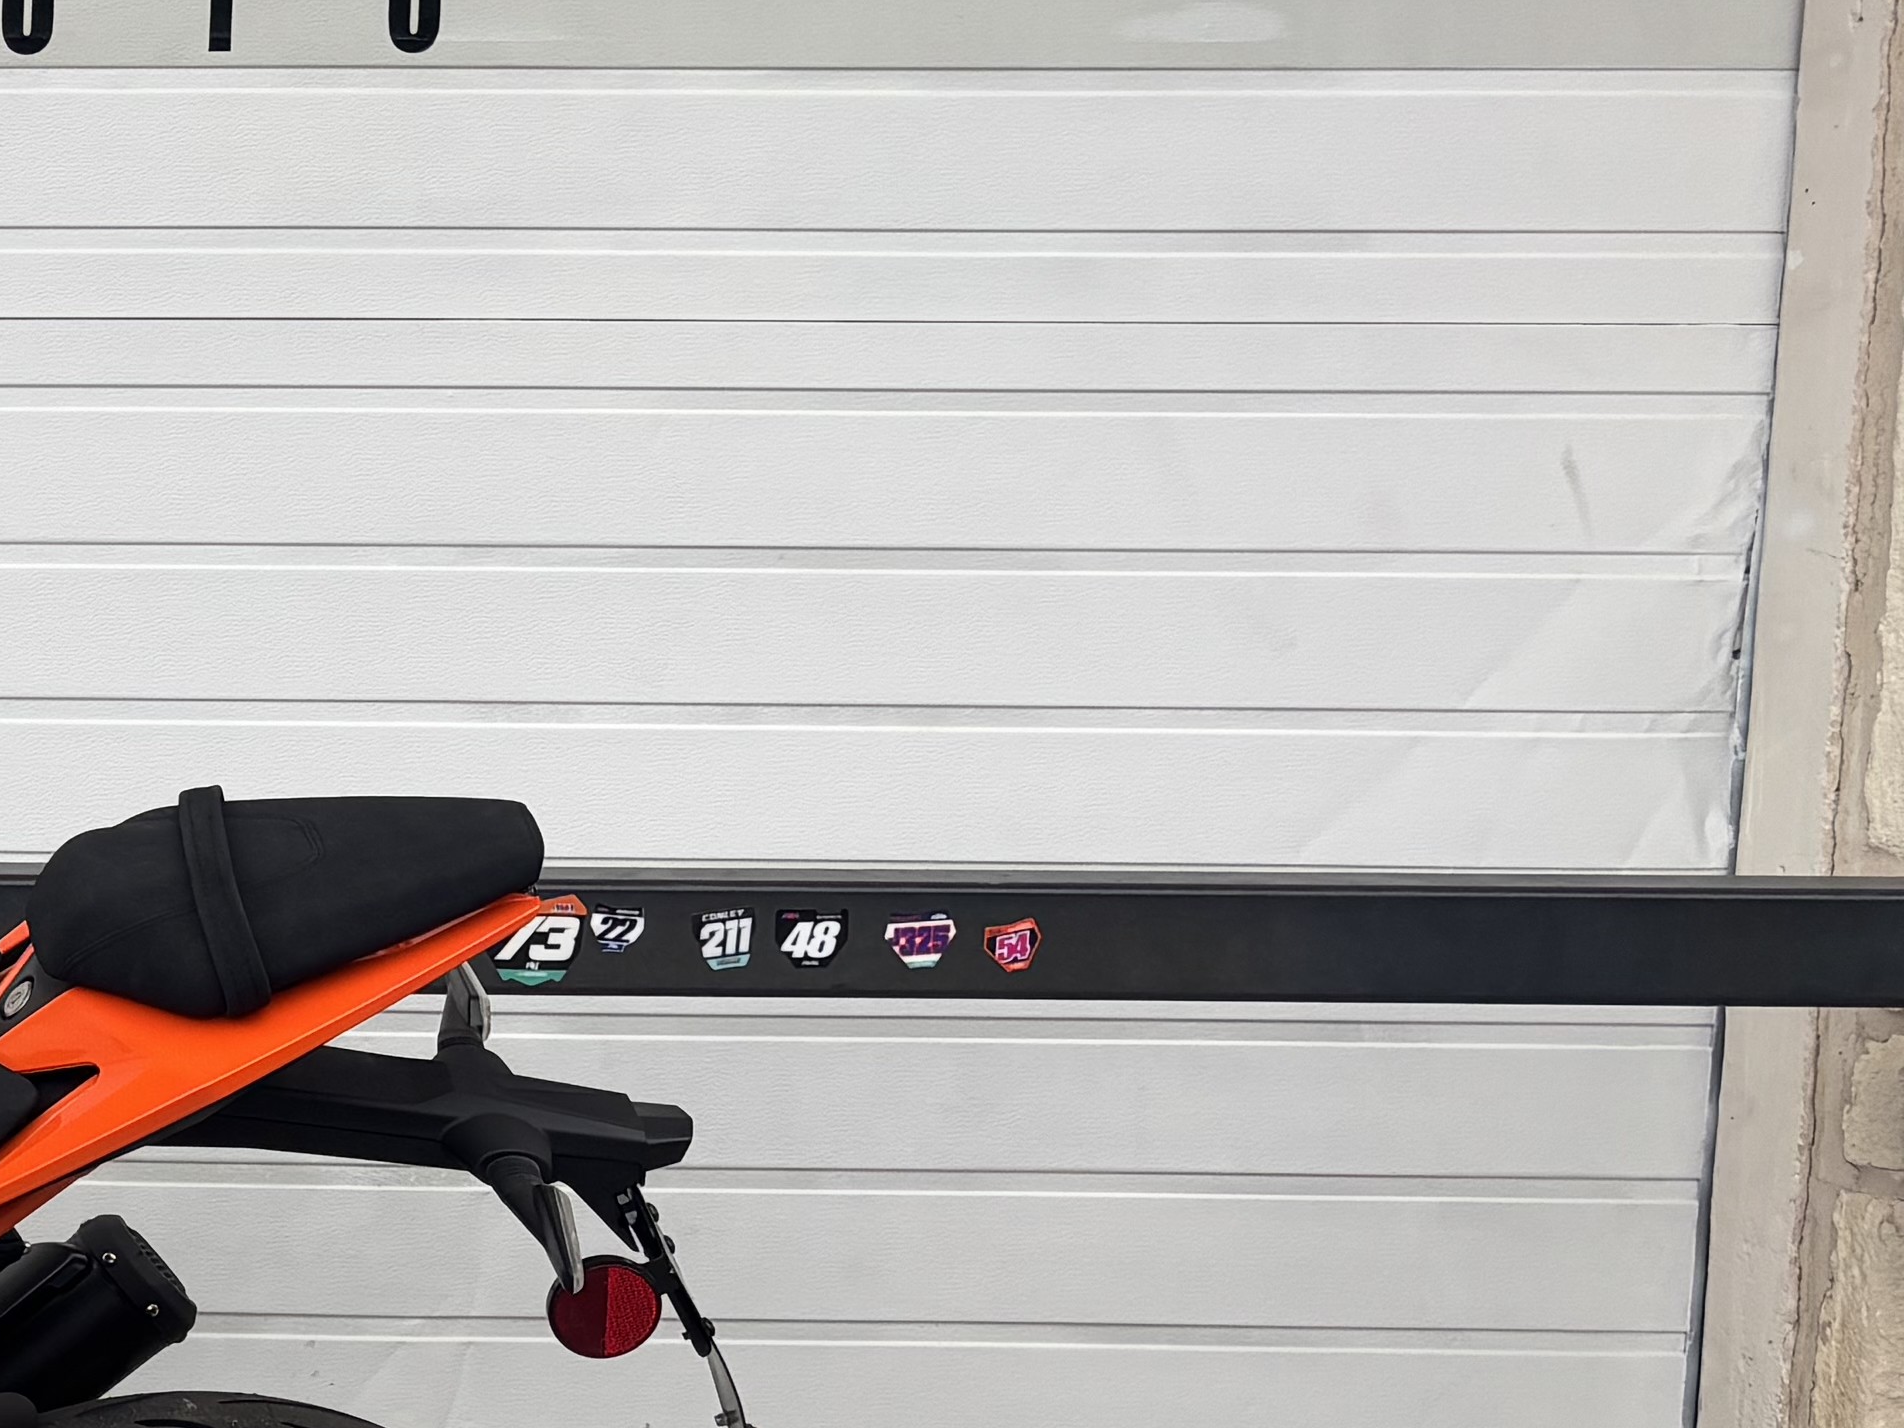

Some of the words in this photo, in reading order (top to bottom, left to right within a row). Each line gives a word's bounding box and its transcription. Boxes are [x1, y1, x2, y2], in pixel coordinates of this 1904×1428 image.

[597, 916, 638, 944] 22
[702, 909, 744, 922] CONLEY
[700, 917, 752, 958] 211
[780, 921, 841, 958] 48
[996, 930, 1030, 963] 54
